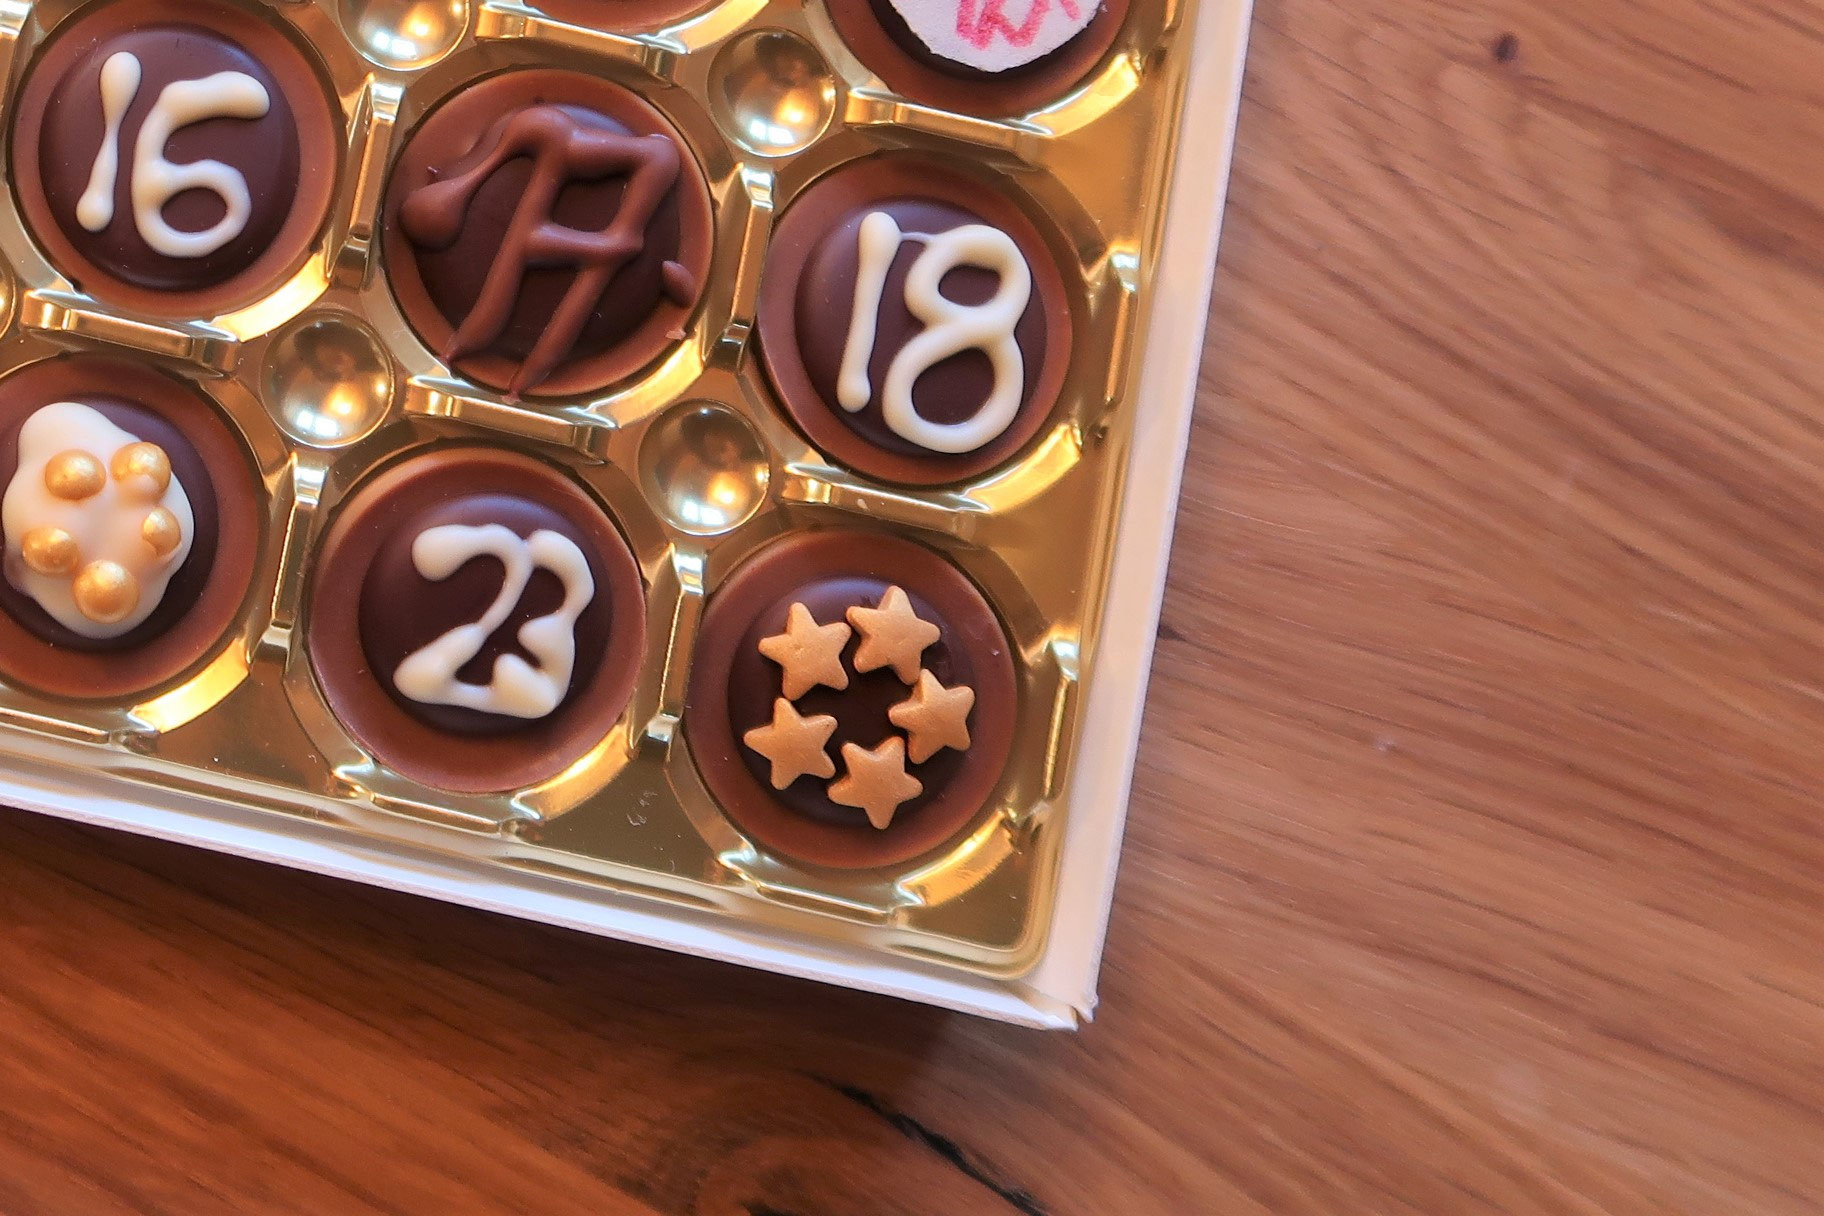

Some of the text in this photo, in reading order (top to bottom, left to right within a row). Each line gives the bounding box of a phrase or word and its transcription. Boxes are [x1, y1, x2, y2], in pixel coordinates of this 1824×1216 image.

[76, 51, 270, 258] 16
[837, 211, 1032, 454] 18
[393, 523, 595, 718] 23
